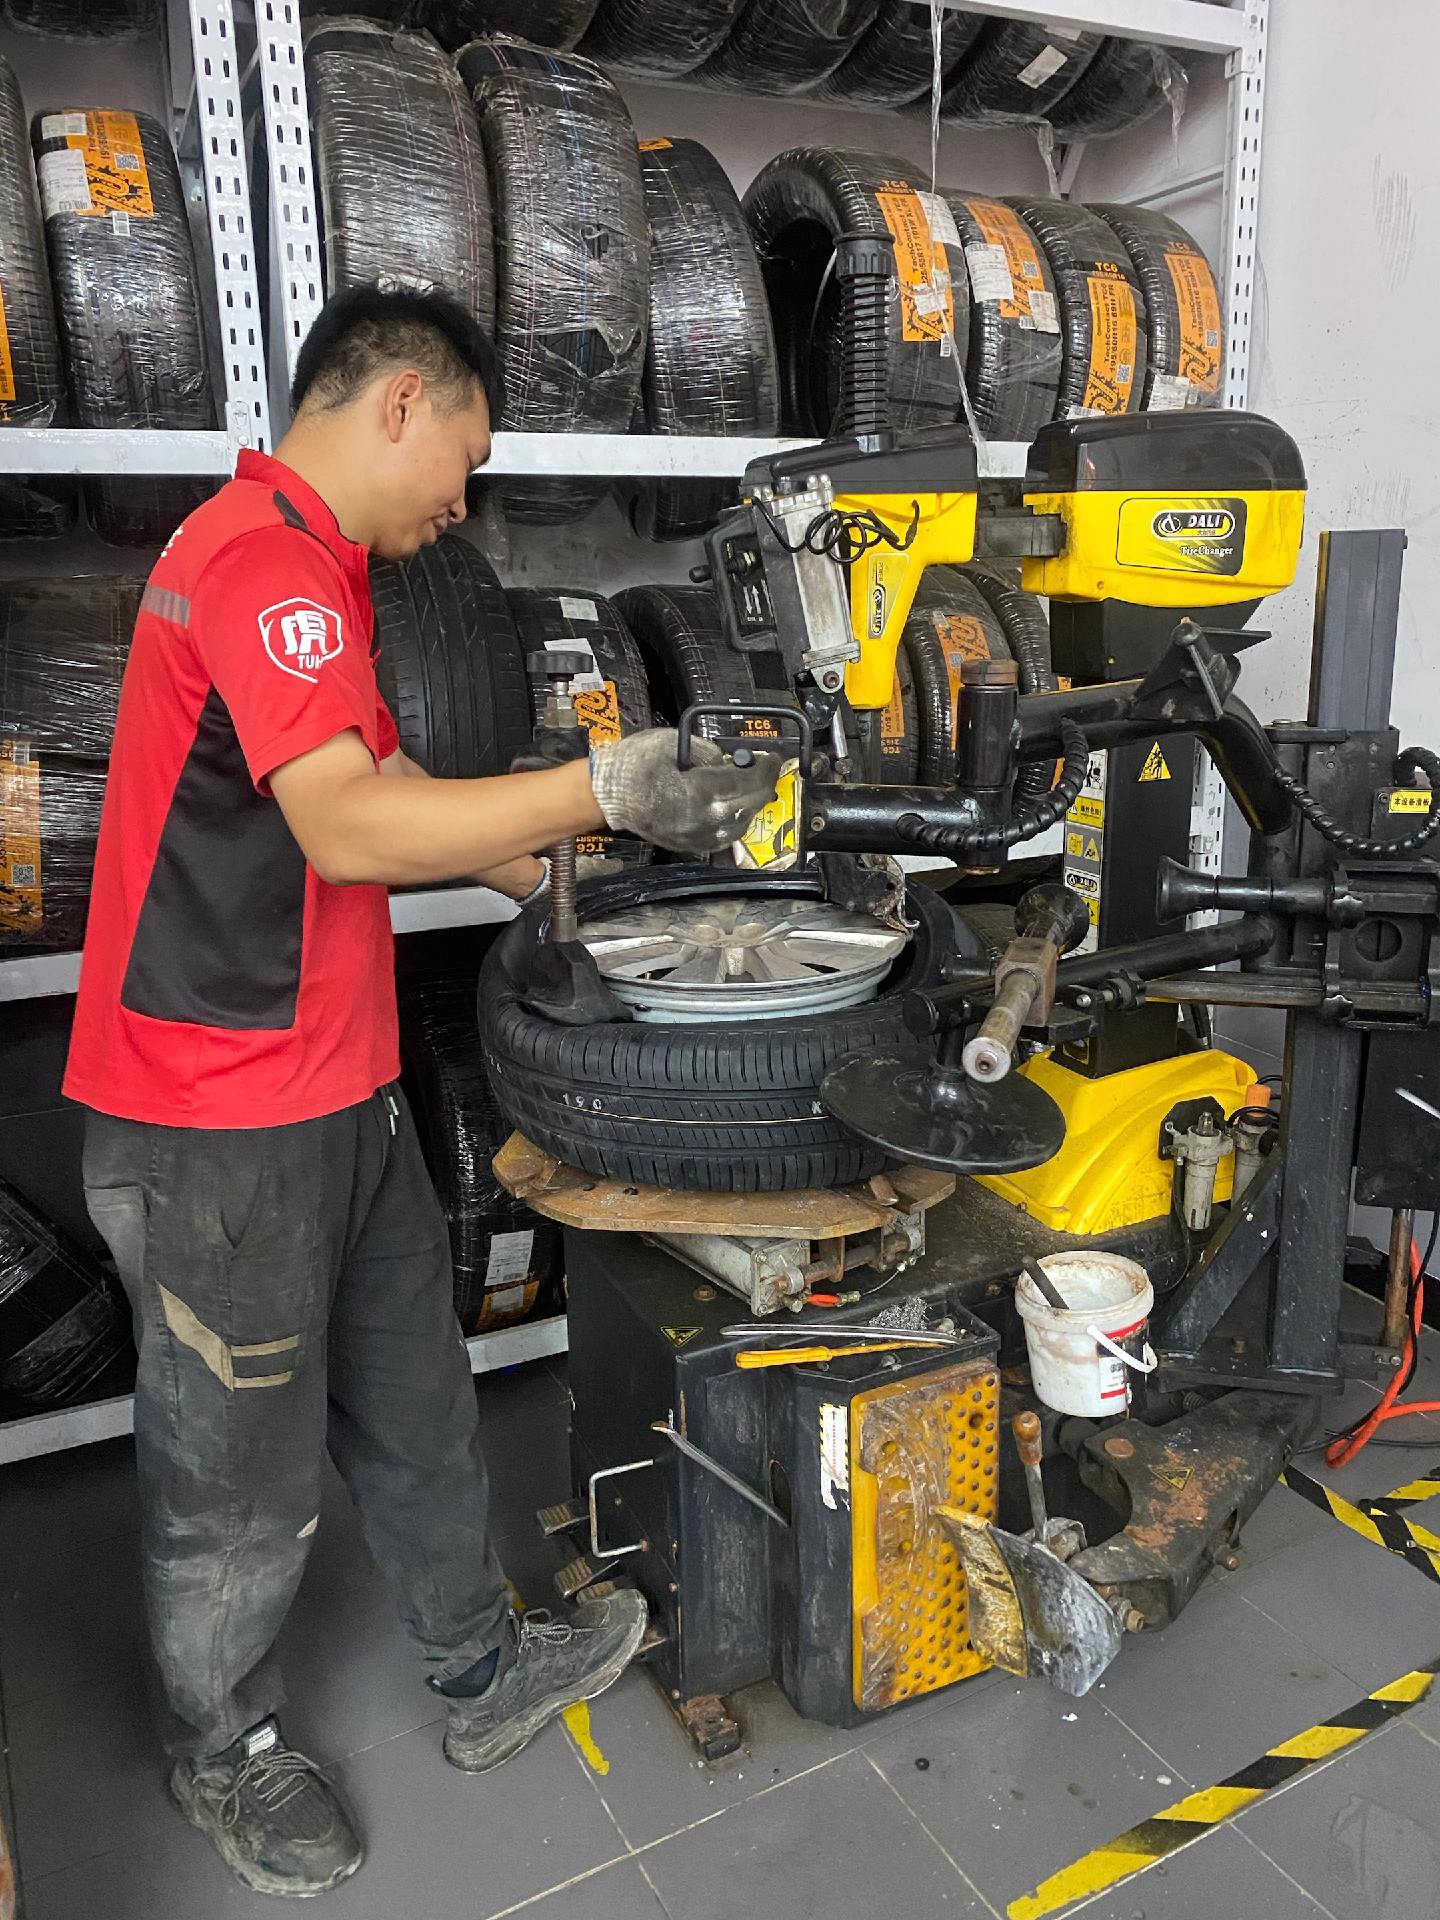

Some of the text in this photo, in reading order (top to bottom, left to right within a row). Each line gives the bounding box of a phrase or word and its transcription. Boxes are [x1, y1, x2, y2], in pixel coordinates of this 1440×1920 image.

[901, 214, 919, 272] TechContact
[1094, 262, 1118, 273] TC6
[1184, 274, 1198, 329] TechContact
[1103, 303, 1112, 363] TechContact
[1187, 514, 1221, 528] DALI
[745, 719, 771, 730] TC6
[576, 842, 605, 853] TC6
